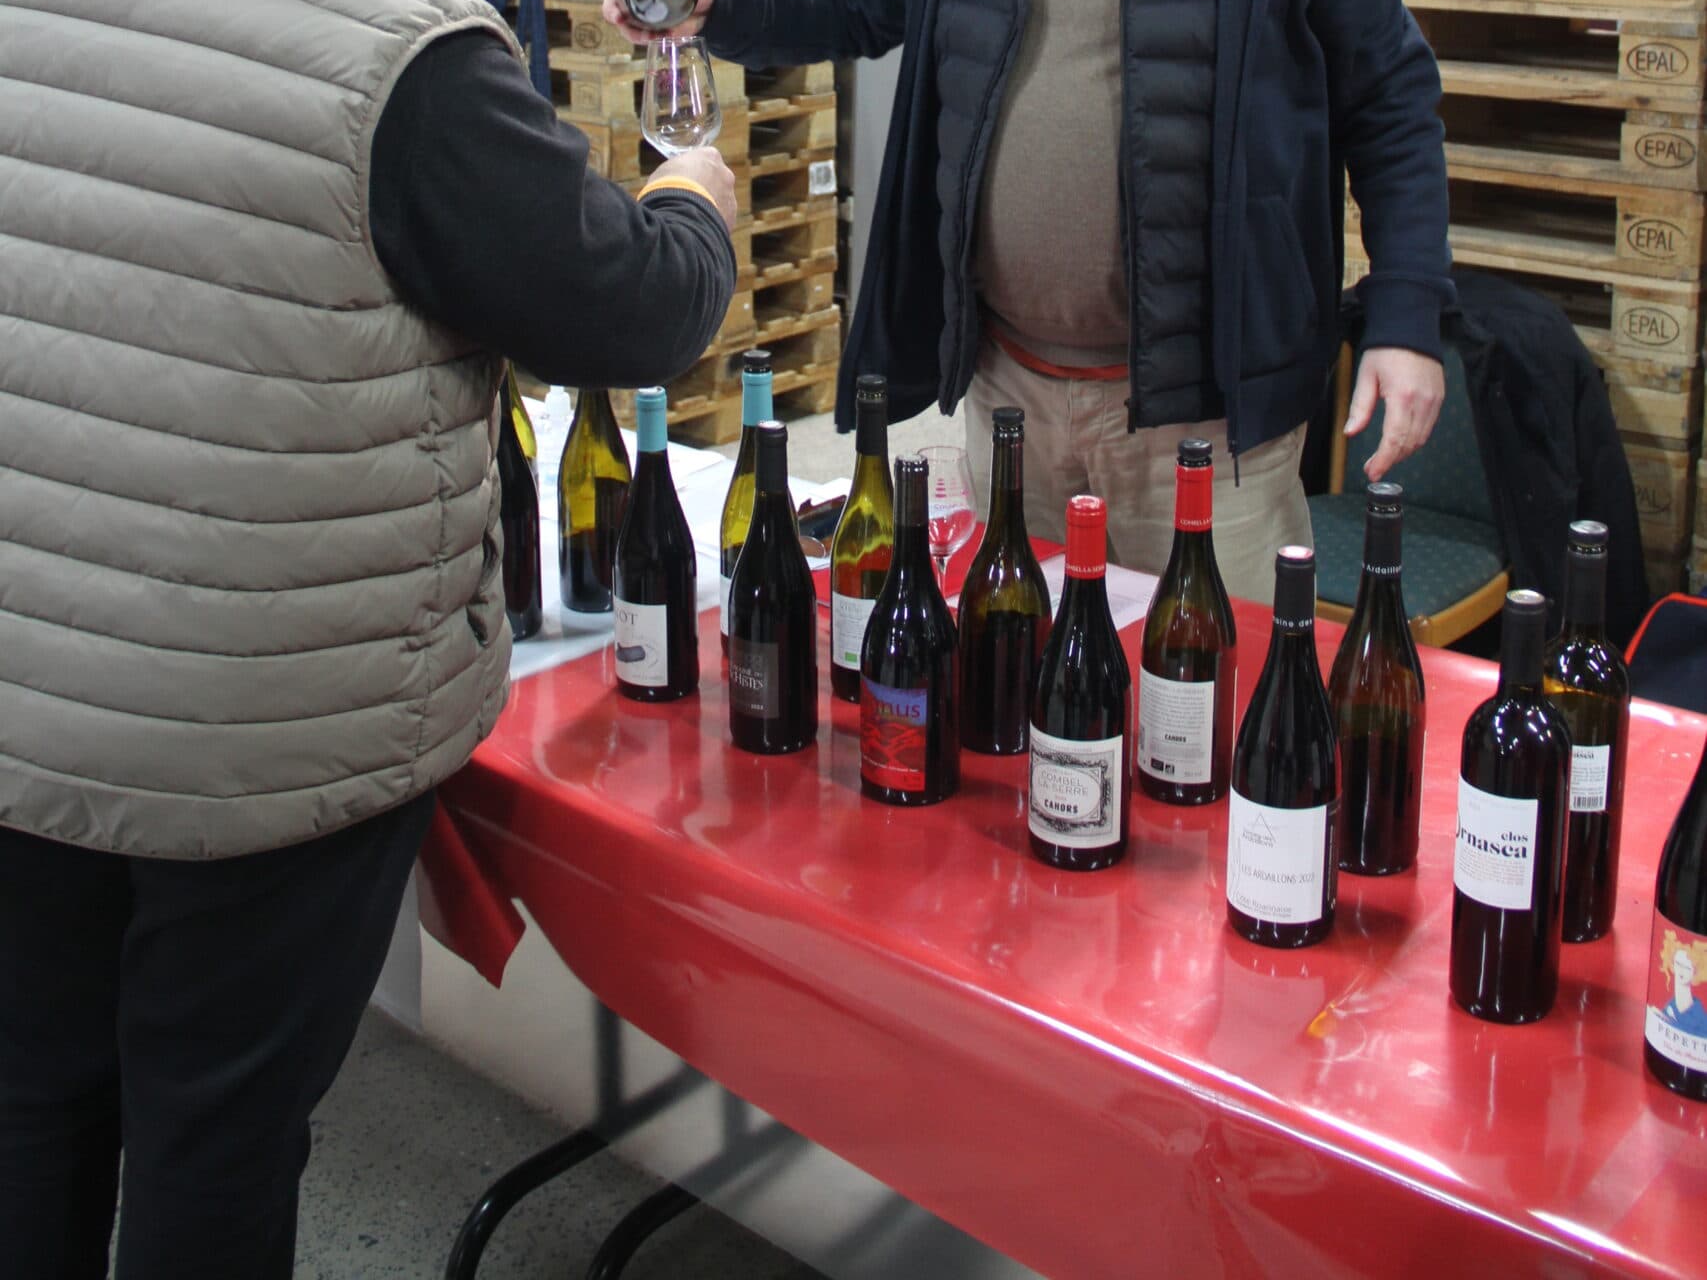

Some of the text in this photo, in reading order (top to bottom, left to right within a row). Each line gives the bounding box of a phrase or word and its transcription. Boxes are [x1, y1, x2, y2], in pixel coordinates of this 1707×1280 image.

[1635, 49, 1678, 73] EPAL
[1644, 139, 1686, 161] EPAL
[1635, 227, 1676, 251] EPAL
[1628, 315, 1670, 339] EPAL
[1044, 799, 1079, 815] CAHORS
[1501, 831, 1529, 843] clos
[1253, 869, 1297, 885] ARDAILLONS
